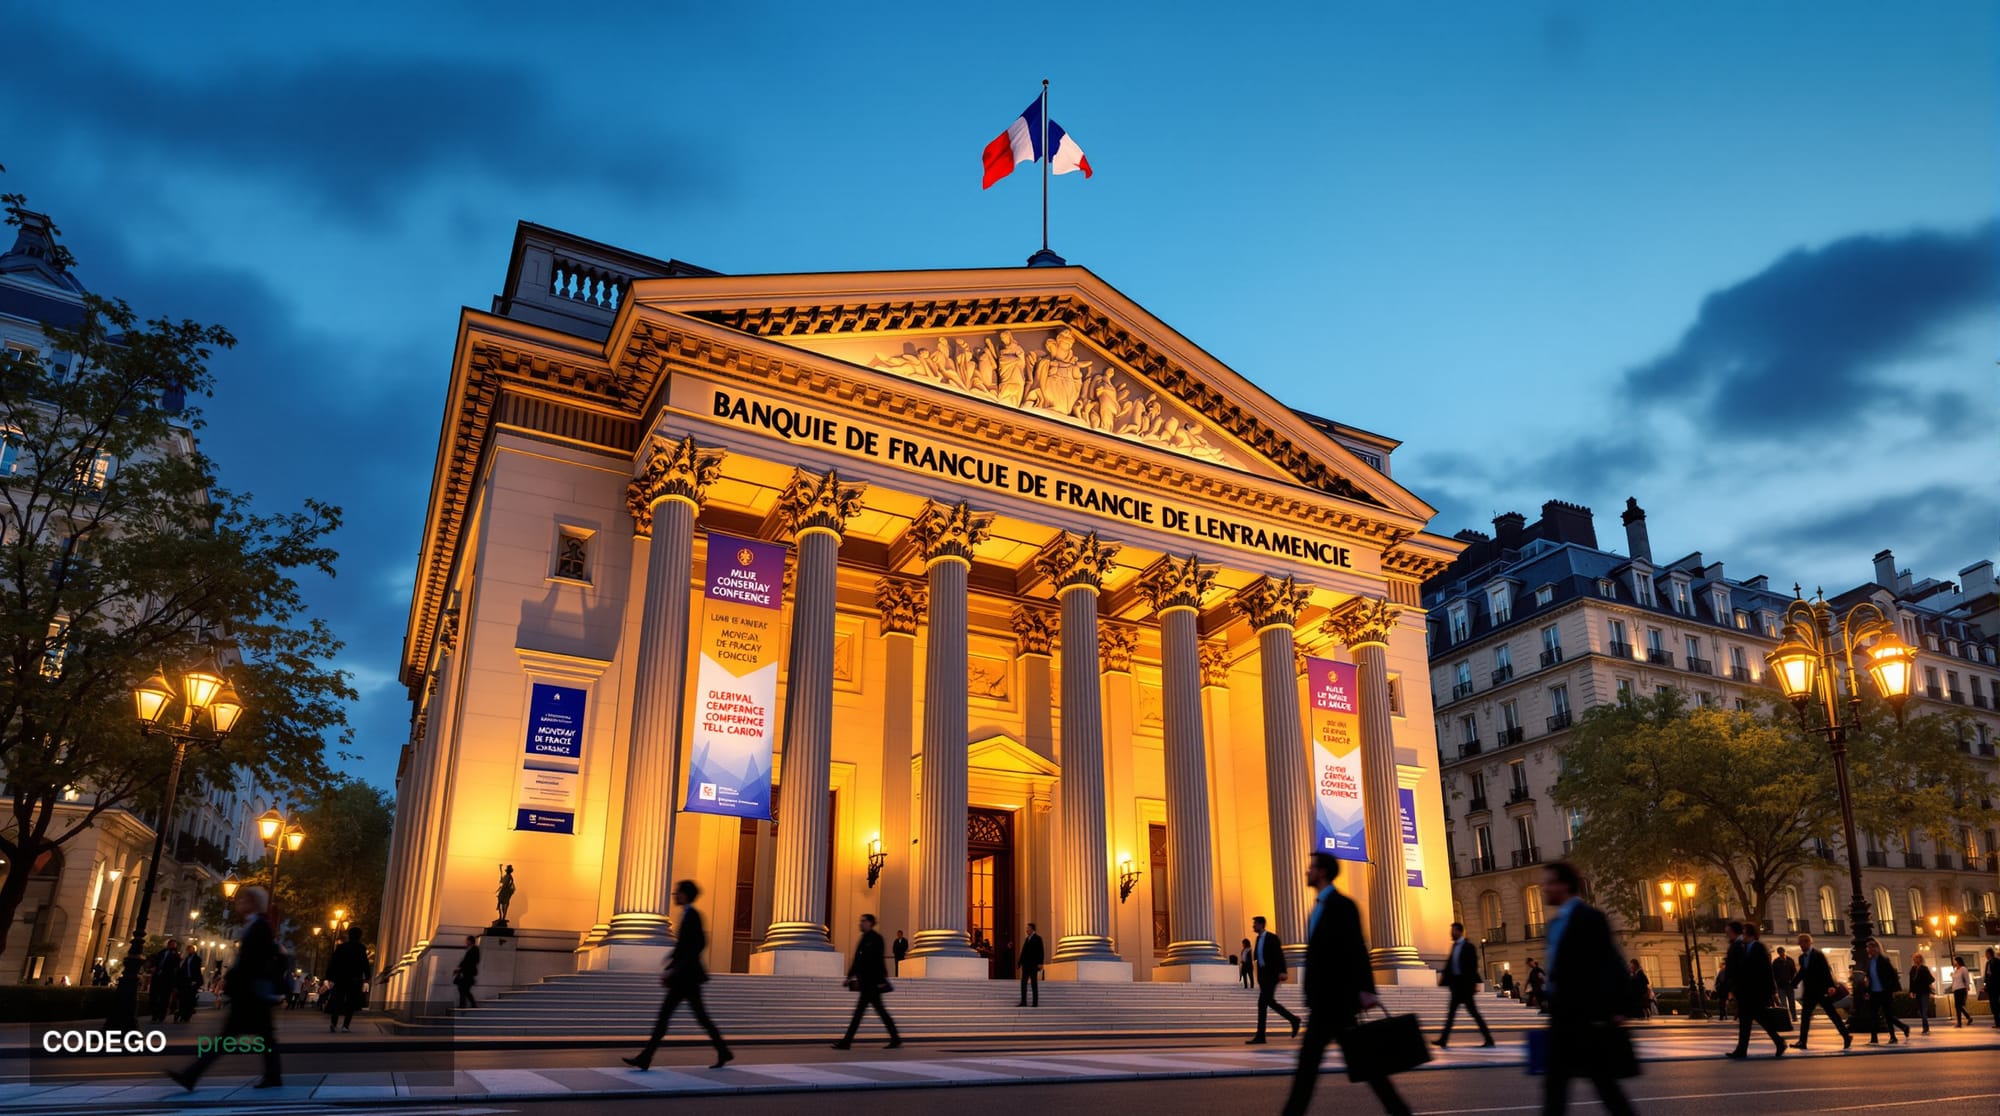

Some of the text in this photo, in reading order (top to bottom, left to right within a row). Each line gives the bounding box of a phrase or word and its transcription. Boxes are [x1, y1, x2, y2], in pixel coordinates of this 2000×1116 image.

[713, 391, 837, 445] BANQUIE
[845, 425, 879, 456] DE
[888, 437, 1009, 488] FRANCUE
[1018, 470, 1047, 498] DE
[1055, 480, 1153, 523] FRANCIE
[1162, 506, 1189, 532] DE
[703, 722, 724, 733] TELL
